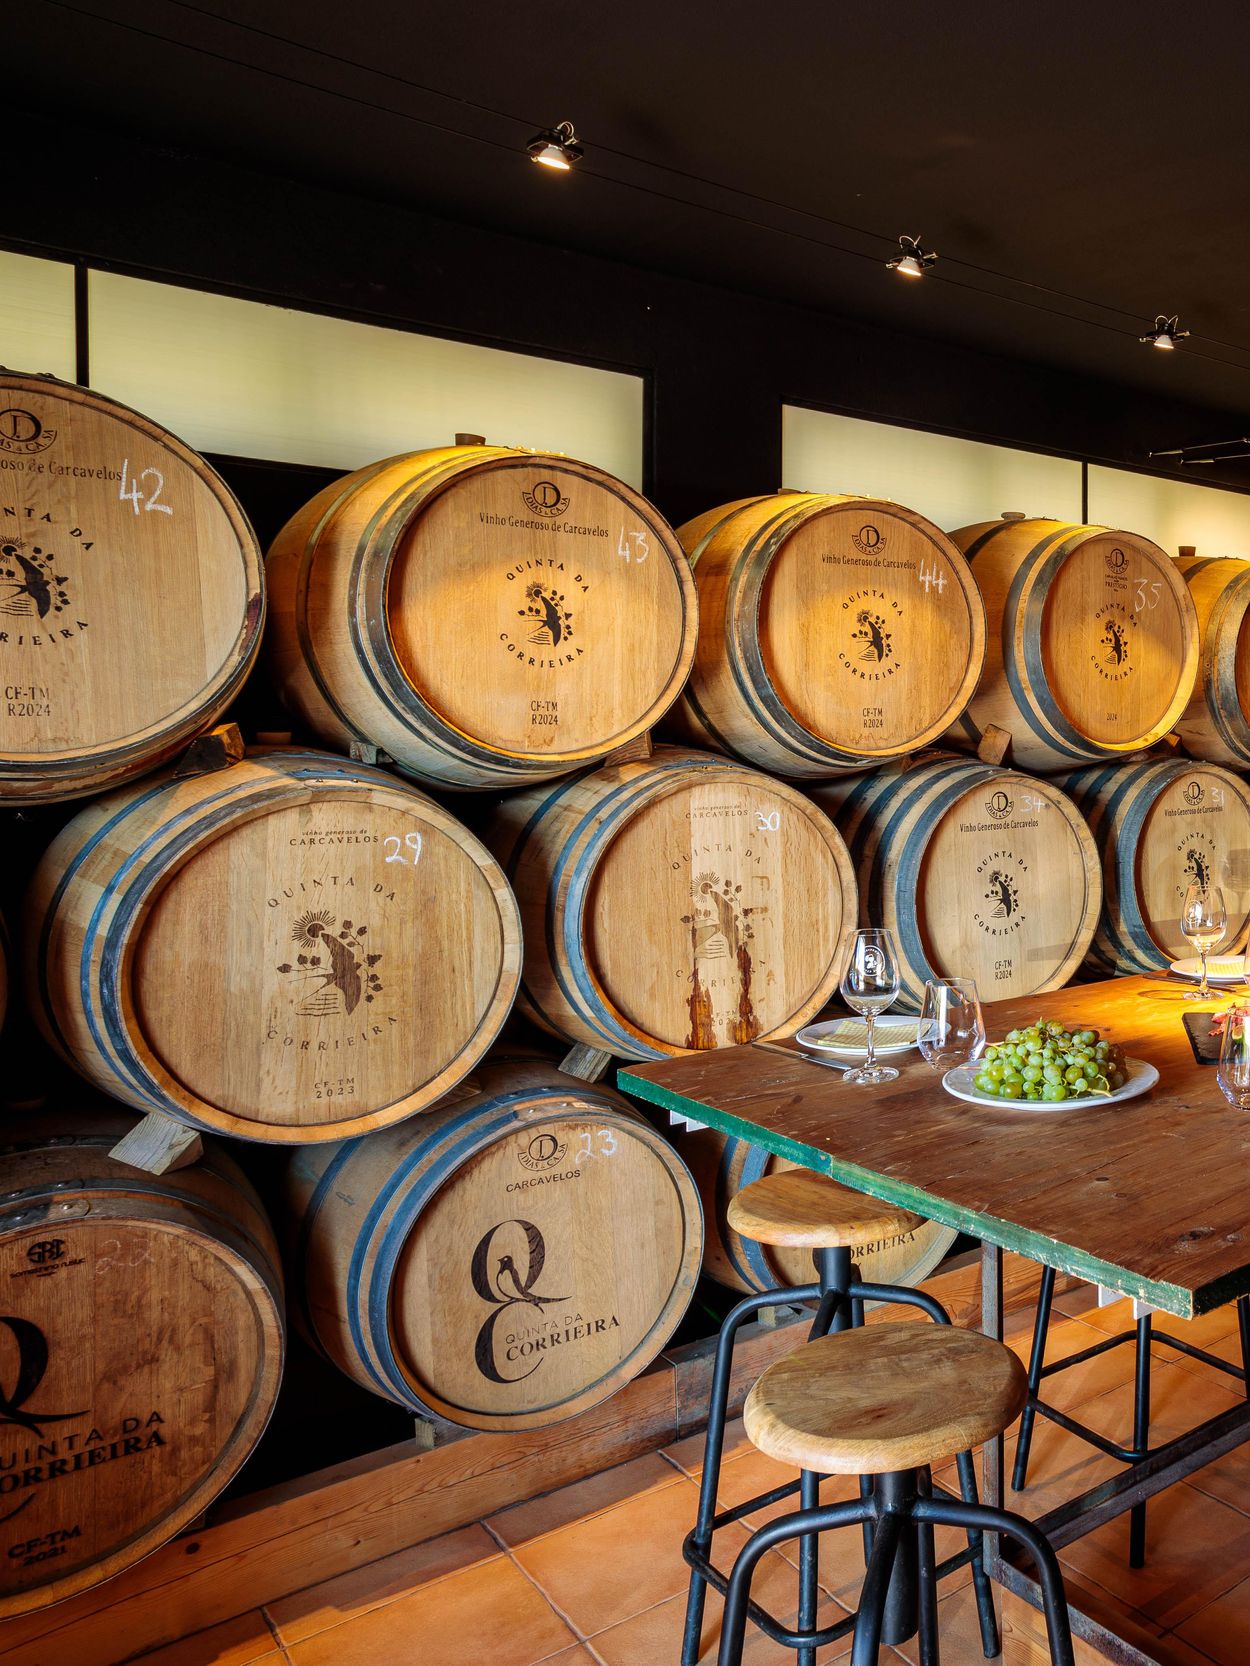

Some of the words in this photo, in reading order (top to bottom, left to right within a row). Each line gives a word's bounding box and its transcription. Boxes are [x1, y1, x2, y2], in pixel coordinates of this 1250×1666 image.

[29, 459, 45, 473] de
[49, 461, 122, 482] Carcavelos
[119, 458, 173, 515] 42
[3, 506, 52, 522] NTA
[69, 527, 94, 551] DA
[479, 512, 506, 526] Vinho
[508, 515, 550, 531] Generoso
[551, 520, 562, 533] de
[563, 522, 609, 538] Carcavelos
[617, 526, 649, 564] 43
[821, 554, 842, 565] Vinho
[842, 555, 873, 568] Generoso
[873, 557, 882, 567] de
[882, 558, 917, 570] Carcavelos
[506, 558, 565, 581] QUINTA
[574, 574, 590, 593] DA
[919, 559, 947, 593] 44
[842, 589, 885, 610] QUINTA
[891, 601, 904, 616] DA
[1134, 577, 1162, 612] 35
[1096, 602, 1126, 620] QUINTA
[1129, 613, 1138, 628] DA
[0, 620, 89, 646] RIEIRA
[499, 633, 584, 668] CORRIEIRA
[838, 652, 901, 681] CORRIEIRA
[1091, 655, 1133, 681] CORRIEIRA
[8, 703, 51, 716] R2024
[530, 700, 558, 712] CF-TM
[862, 707, 883, 718] CF-TM
[531, 714, 558, 725] R2024
[863, 719, 884, 728] R2024
[1020, 795, 1046, 813] 34
[1210, 787, 1225, 805] 31
[685, 809, 748, 819] CARCAVELOS
[755, 811, 780, 831] 30
[960, 823, 977, 833] Vinho
[977, 820, 1003, 832] Generoso
[1003, 820, 1010, 829] de
[1010, 818, 1039, 829] Carcavelos
[289, 836, 379, 846] CARCAVELOS
[383, 831, 422, 865] 29
[1177, 832, 1205, 851] QUINTA
[1208, 839, 1216, 851] DA
[671, 844, 732, 871] QUINTA
[745, 849, 762, 865] DA
[976, 850, 1013, 873] QUINTA
[1018, 858, 1028, 872] DA
[267, 875, 355, 909] QUINTA
[373, 883, 396, 901] DA
[974, 913, 1026, 936] CORRIEIRA
[994, 959, 1013, 970] CF-TM
[994, 970, 1013, 981] R2024
[266, 1015, 398, 1051] CORRIEIRA
[316, 1085, 355, 1099] 2023
[576, 1130, 618, 1164] 23
[506, 1169, 581, 1193] CARCAVELOS
[850, 1232, 916, 1260] ORRIEIRA
[506, 1321, 558, 1345] QUINTA
[564, 1313, 583, 1326] DA
[506, 1315, 620, 1361] CORRIEIRA
[0, 1428, 104, 1471] UINTA
[122, 1411, 165, 1435] DA
[0, 1430, 167, 1494] ORRIEIRA
[8, 1525, 82, 1559] CF-TM
